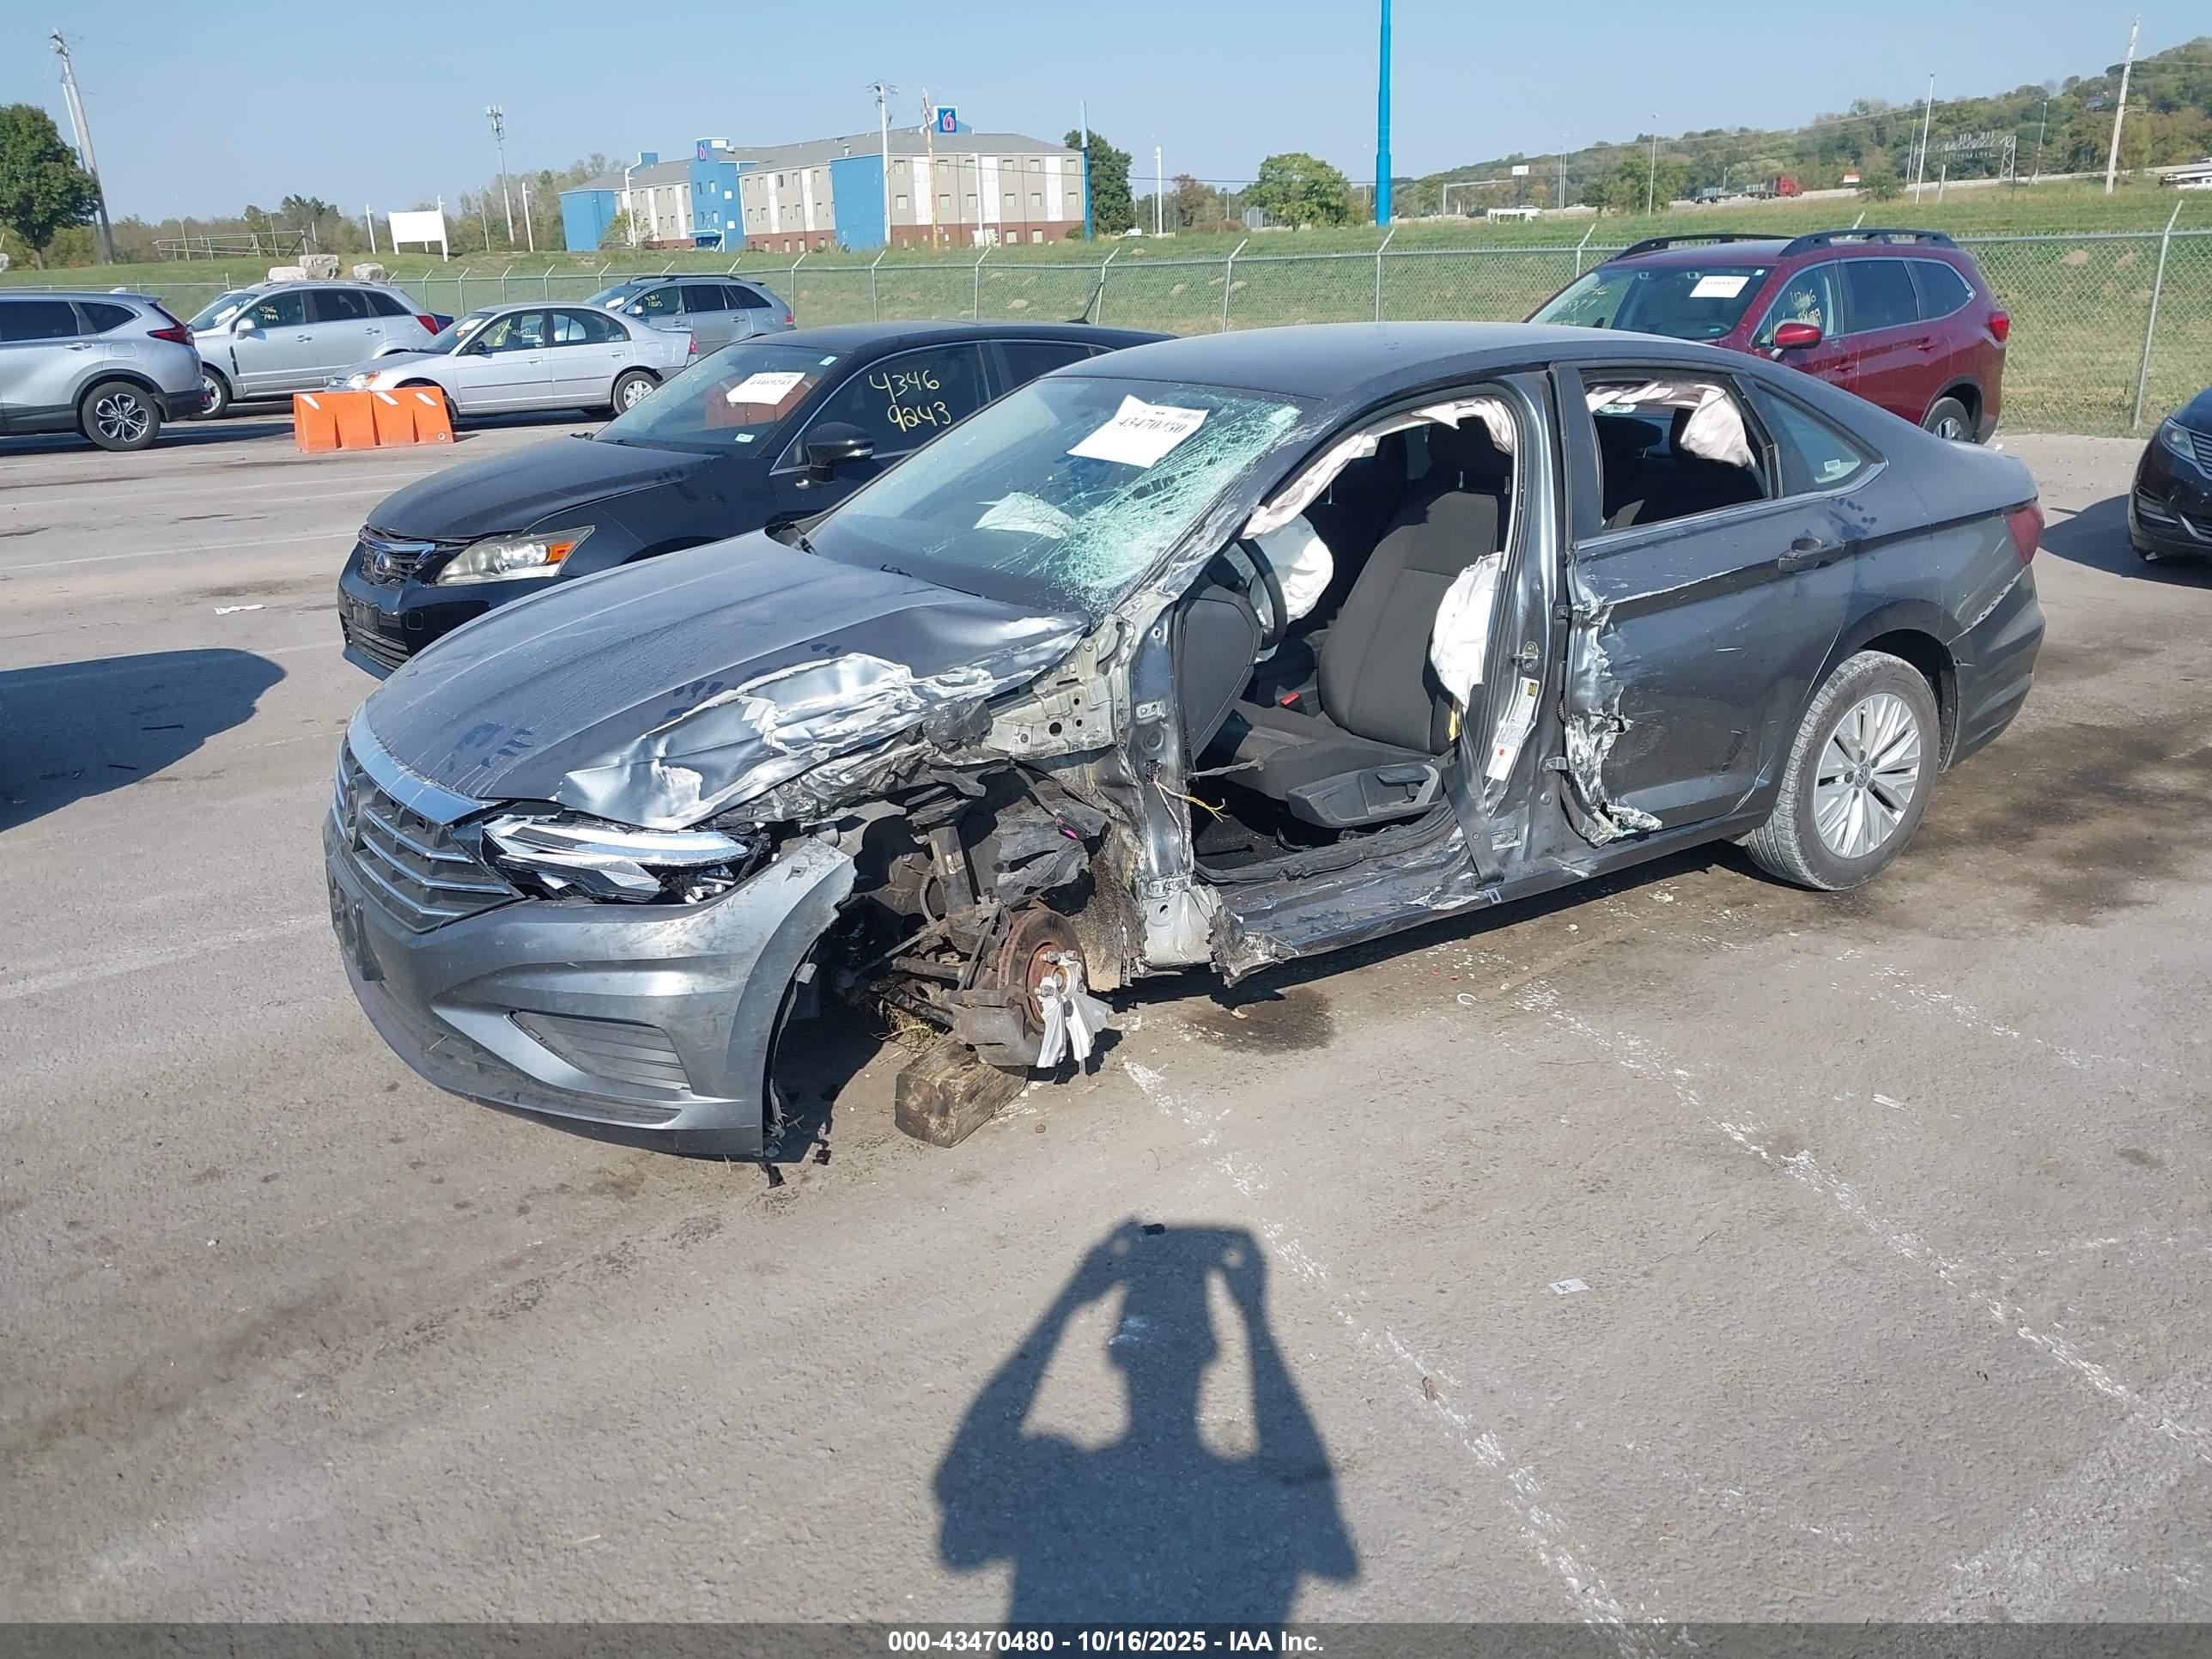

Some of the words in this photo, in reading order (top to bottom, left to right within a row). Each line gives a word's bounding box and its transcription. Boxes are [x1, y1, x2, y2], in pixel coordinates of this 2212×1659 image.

[942, 111, 956, 131] 6
[869, 369, 940, 404] 4346
[887, 401, 951, 432] 9243
